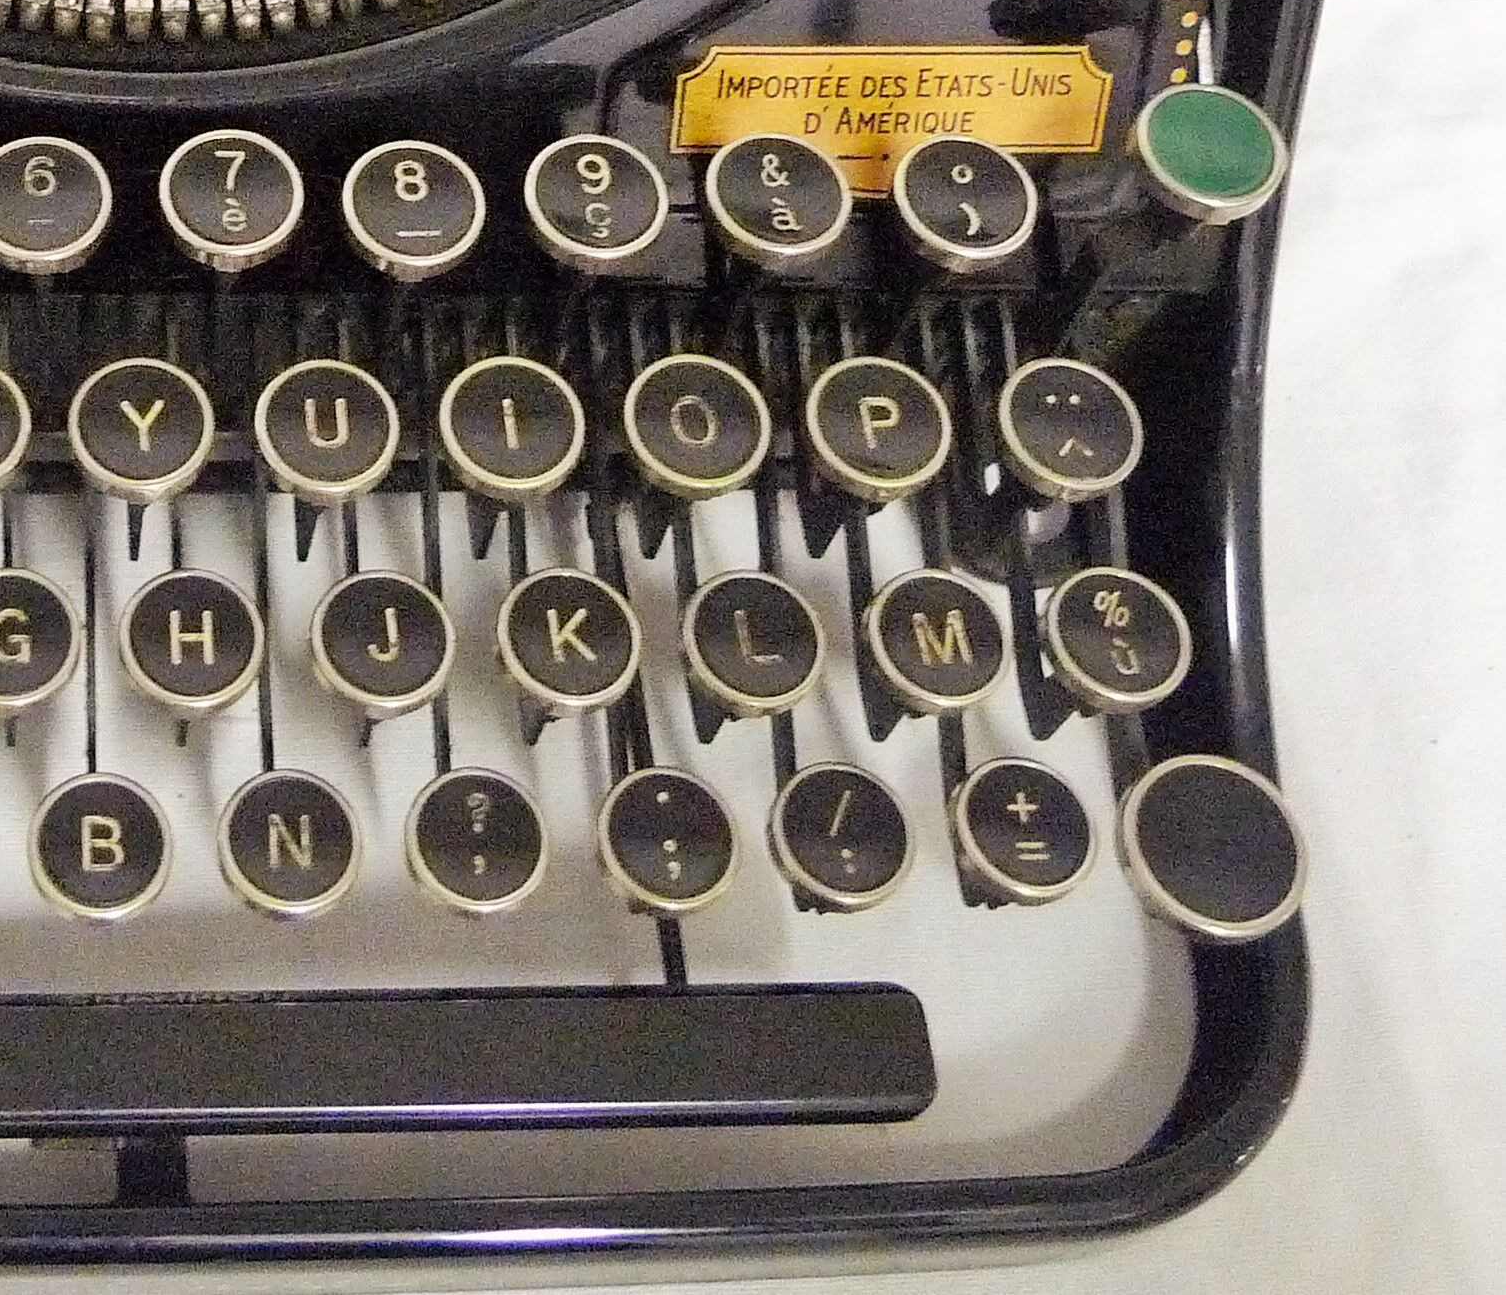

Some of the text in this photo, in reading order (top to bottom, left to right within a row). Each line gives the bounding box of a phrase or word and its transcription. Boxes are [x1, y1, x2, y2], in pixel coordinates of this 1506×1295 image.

[716, 63, 852, 100] IMPORTÉE
[860, 73, 909, 99] DES
[24, 155, 56, 197] 6
[214, 150, 246, 191] 7
[394, 159, 428, 202] 8
[576, 153, 612, 195] 9
[761, 153, 791, 188] &
[120, 399, 165, 452] Y
[304, 398, 348, 448] U
[502, 398, 519, 450] I
[670, 394, 716, 445] O
[858, 396, 900, 449] P
[367, 607, 399, 662] J
[1093, 590, 1130, 629] %
[170, 609, 216, 665] H
[547, 608, 598, 663] K
[733, 609, 784, 664] L
[911, 608, 974, 666] M
[1006, 790, 1040, 824] +
[80, 815, 126, 873] B
[267, 813, 313, 870] N
